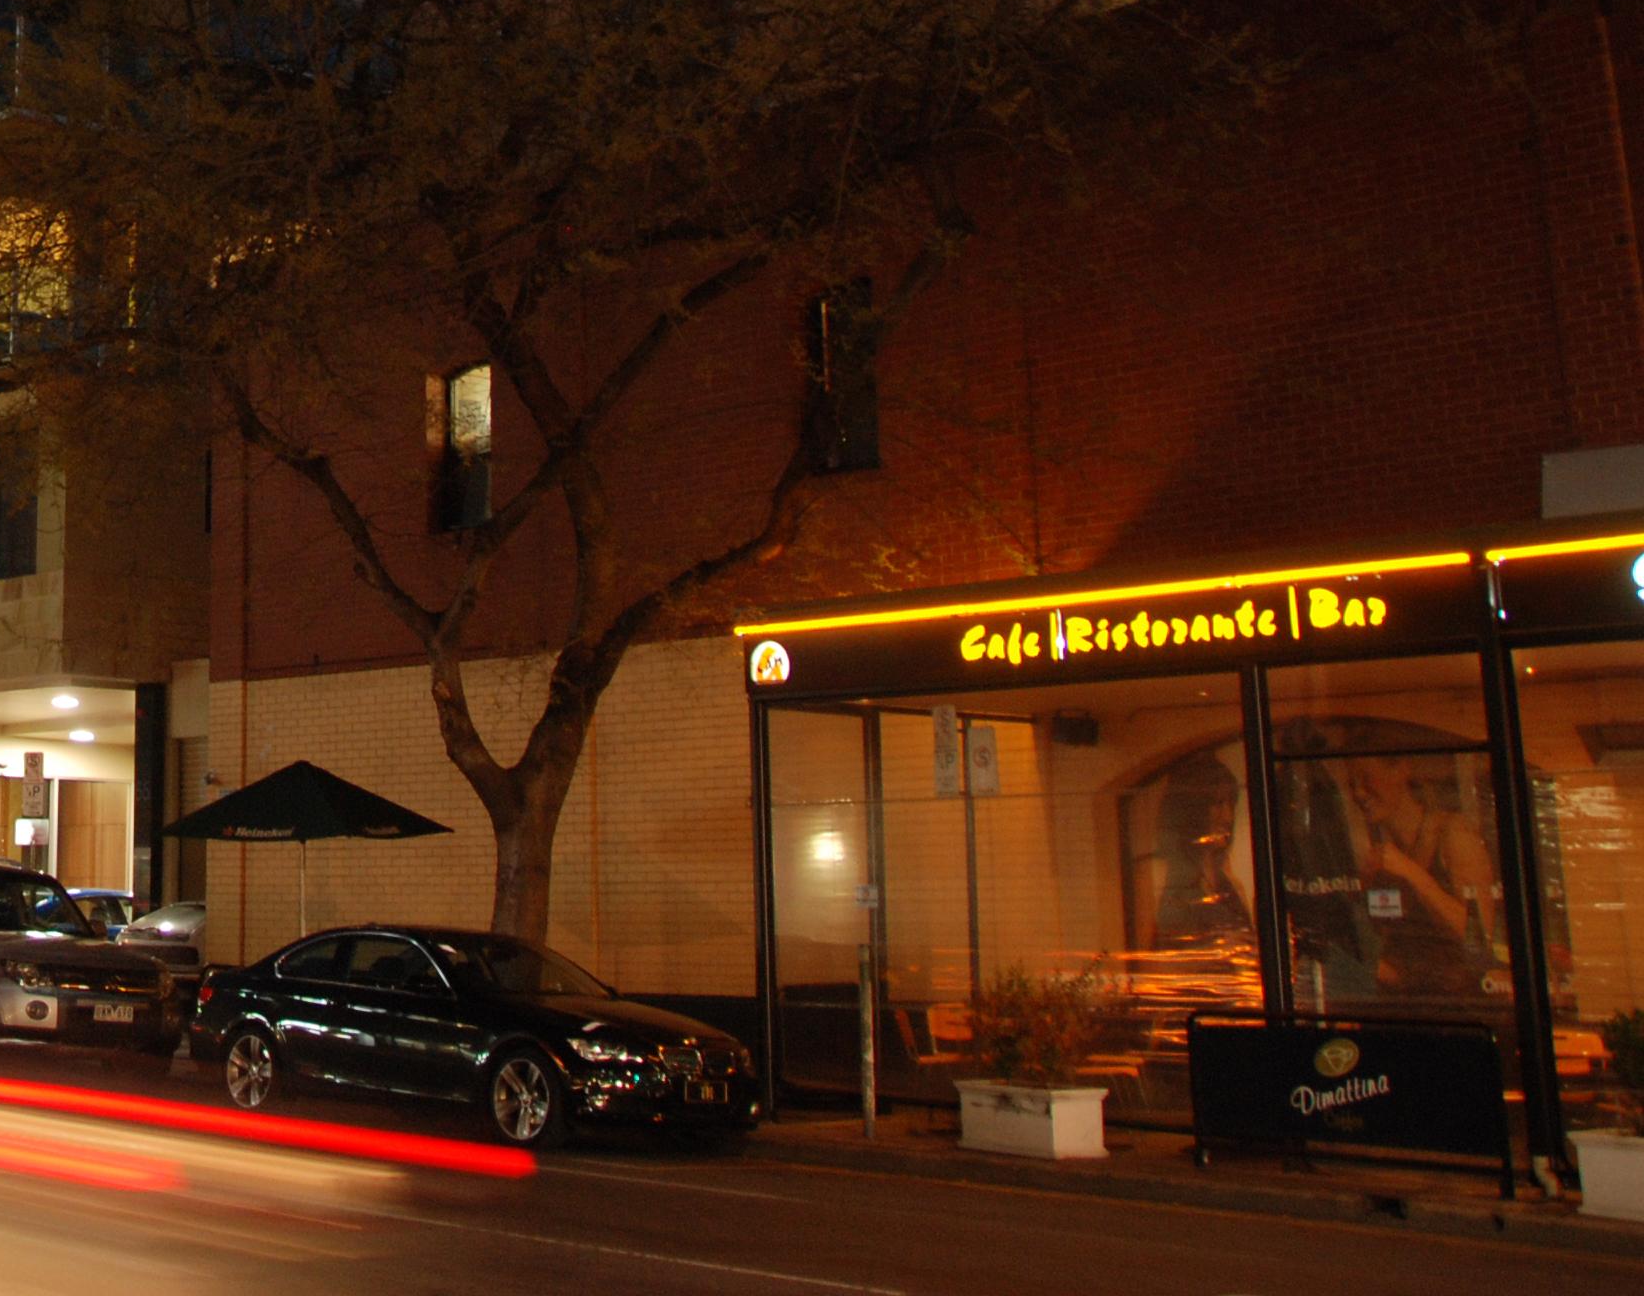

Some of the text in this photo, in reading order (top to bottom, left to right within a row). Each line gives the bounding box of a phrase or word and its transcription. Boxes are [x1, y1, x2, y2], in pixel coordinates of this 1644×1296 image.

[960, 587, 1387, 665] Cafe Ristorante Bar
[1290, 1074, 1390, 1115] Dimattina
